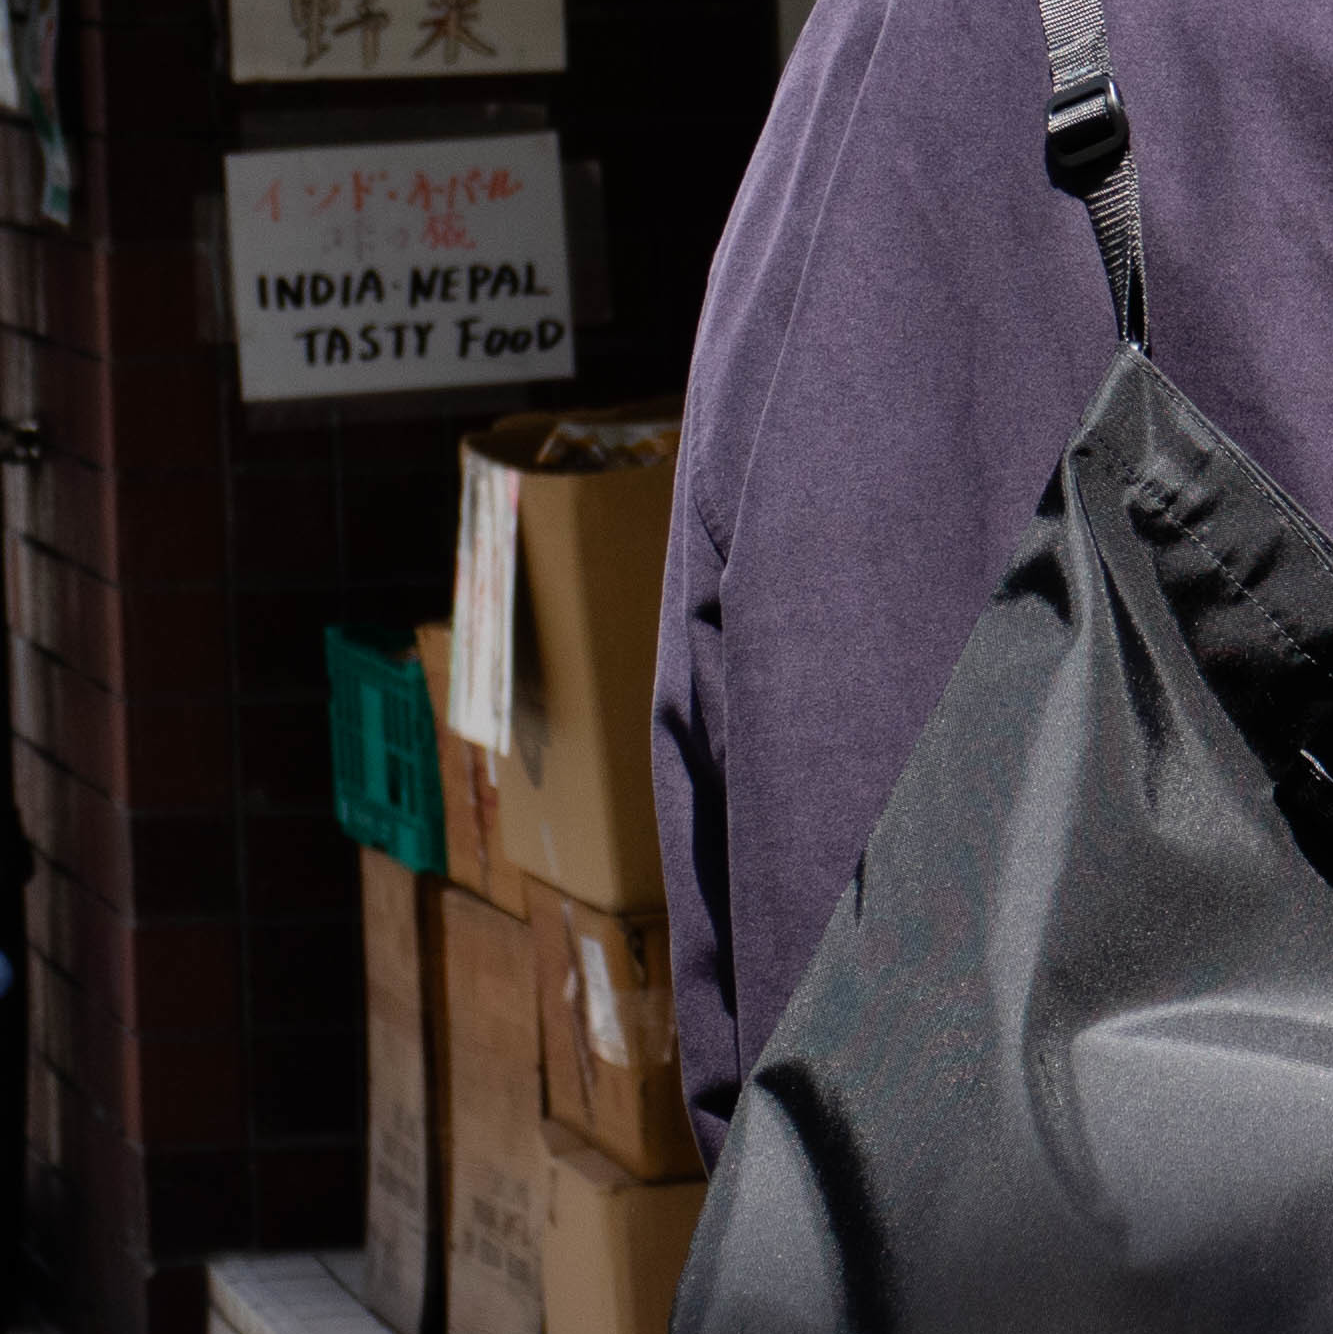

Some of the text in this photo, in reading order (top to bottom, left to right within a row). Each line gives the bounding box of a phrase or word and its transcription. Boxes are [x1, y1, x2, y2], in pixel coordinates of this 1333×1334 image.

[256, 261, 552, 310] INDIA NEPAL
[294, 321, 433, 366] TASTY
